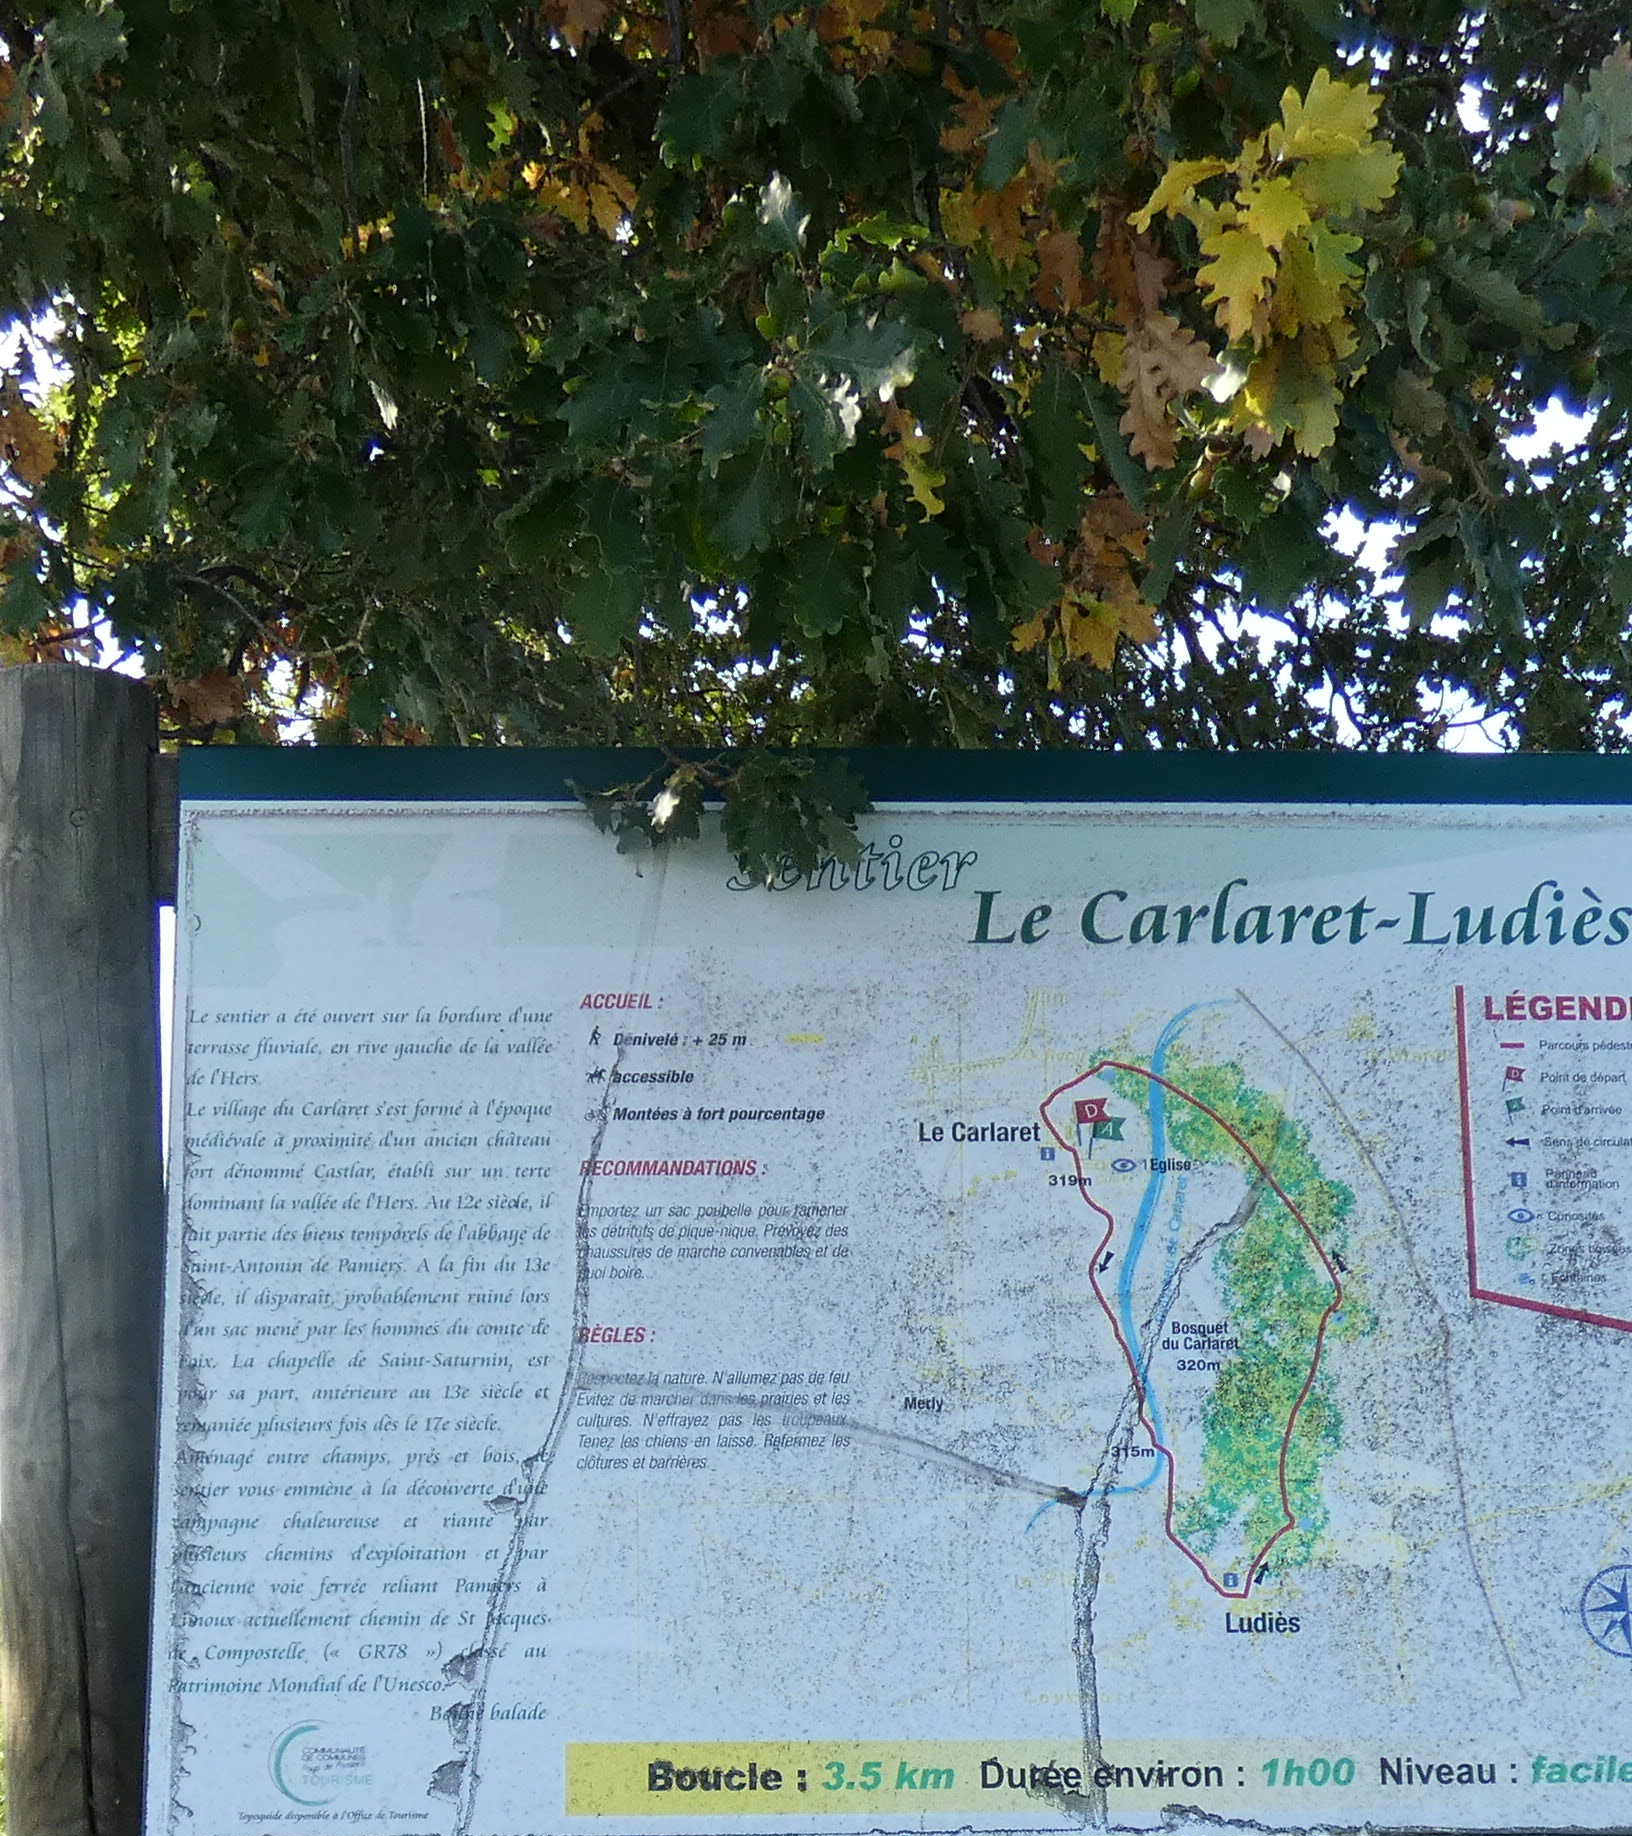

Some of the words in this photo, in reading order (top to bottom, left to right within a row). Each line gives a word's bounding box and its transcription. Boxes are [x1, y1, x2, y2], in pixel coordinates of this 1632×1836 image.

[970, 890, 1050, 945] Le
[580, 993, 653, 1009] ACCUEIL
[188, 1009, 208, 1023] Le
[216, 1009, 268, 1023] sentier
[276, 1011, 285, 1023] a
[294, 1008, 318, 1023] été
[323, 1010, 375, 1023] ouvert
[382, 1012, 408, 1023] sur
[416, 1006, 430, 1023] la
[439, 1006, 502, 1023] bordure
[509, 1006, 553, 1023] d'une
[613, 1033, 678, 1046] Dénivelé
[693, 1037, 703, 1046] +
[709, 1033, 727, 1046] 25
[732, 1035, 747, 1046] m
[1539, 1040, 1589, 1050] Parcours
[187, 1041, 249, 1054] terrasse
[249, 1038, 322, 1060] fluviale,
[331, 1043, 349, 1054] en
[357, 1041, 387, 1054] rive
[393, 1039, 451, 1061] gauche
[459, 1039, 477, 1054] de
[484, 1039, 499, 1054] la
[508, 1037, 553, 1054] vallée
[186, 1069, 204, 1085] de
[613, 1071, 694, 1083] accessible
[1541, 1072, 1568, 1083] Point
[1573, 1072, 1586, 1082] de
[1590, 1071, 1626, 1084] départ
[186, 1102, 205, 1117] Le
[213, 1101, 267, 1121] village
[273, 1101, 294, 1117] du
[302, 1100, 368, 1117] Carlaret
[375, 1100, 407, 1117] s'est
[413, 1101, 462, 1123] formé
[469, 1100, 478, 1116] à
[486, 1100, 552, 1123] l'époque
[613, 1107, 678, 1121] Montées
[683, 1107, 691, 1121] à
[697, 1107, 724, 1121] fort
[729, 1108, 825, 1122] pourcentage
[1542, 1105, 1570, 1115] Point
[1574, 1104, 1622, 1114] d'arrivée
[918, 1122, 944, 1142] Le
[951, 1122, 1041, 1143] Carlaret
[185, 1133, 266, 1147] médiévale
[274, 1134, 283, 1147] à
[287, 1134, 370, 1153] proximité
[379, 1132, 415, 1147] d'un
[424, 1134, 477, 1147] ancien
[487, 1132, 551, 1147] château
[1576, 1137, 1590, 1146] de
[580, 1160, 757, 1176] RECOMMANDATIONS
[1150, 1158, 1191, 1173] Eglise
[1048, 1175, 1092, 1187] 319m
[646, 1206, 662, 1217] un
[668, 1206, 691, 1217] sac
[695, 1203, 752, 1220] poubelle
[758, 1205, 788, 1219] pour
[792, 1204, 849, 1217] ramener
[659, 1225, 674, 1238] de
[764, 1224, 821, 1240] Prévoyez
[825, 1224, 848, 1237] des
[657, 1245, 672, 1257] de
[678, 1245, 726, 1257] marche
[731, 1246, 811, 1259] convenables
[815, 1246, 828, 1257] et
[832, 1245, 848, 1257] de
[311, 1258, 329, 1273] de
[338, 1258, 406, 1273] Pamiers.
[416, 1258, 430, 1272] A
[438, 1257, 454, 1273] la
[460, 1257, 486, 1278] fin
[494, 1257, 515, 1272] du
[524, 1258, 551, 1272] 13e
[609, 1266, 644, 1279] boire.
[577, 1324, 646, 1343] RÈGLES
[1172, 1321, 1229, 1337] Bosquet
[1162, 1337, 1179, 1350] du
[1183, 1337, 1239, 1350] Carlaret
[1177, 1360, 1220, 1371] 320m
[648, 1372, 659, 1386] la
[663, 1373, 707, 1384] nature.
[713, 1371, 776, 1384] N'allumez
[780, 1373, 804, 1386] pas
[809, 1371, 824, 1384] de
[830, 1370, 850, 1384] feu
[620, 1393, 636, 1405] de
[641, 1393, 694, 1406] marcher
[760, 1392, 809, 1407] prairies
[814, 1392, 827, 1404] et
[832, 1392, 850, 1404] les
[576, 1413, 632, 1427] cultures.
[643, 1413, 709, 1429] N'effrayez
[718, 1415, 742, 1429] pas
[753, 1413, 771, 1426] les
[578, 1434, 615, 1448] Tenez
[620, 1434, 639, 1448] les
[646, 1434, 688, 1448] chiens
[694, 1436, 710, 1447] en
[764, 1433, 825, 1448] Refermez
[832, 1434, 850, 1447] les
[576, 1455, 628, 1469] clôtures
[633, 1456, 645, 1469] et
[1225, 1613, 1301, 1633] Ludiès
[268, 1675, 343, 1692] Mondial
[348, 1675, 367, 1692] de
[373, 1674, 446, 1692] l'Unesco.
[647, 1760, 782, 1791] Boucle
[822, 1761, 882, 1790] 3.5
[895, 1762, 954, 1790] km
[979, 1759, 1081, 1790] Durée
[1093, 1760, 1223, 1788] environ
[1238, 1766, 1244, 1787] :
[1262, 1757, 1355, 1787] 1h00
[1380, 1757, 1495, 1785] Niveau
[1511, 1764, 1517, 1784] :
